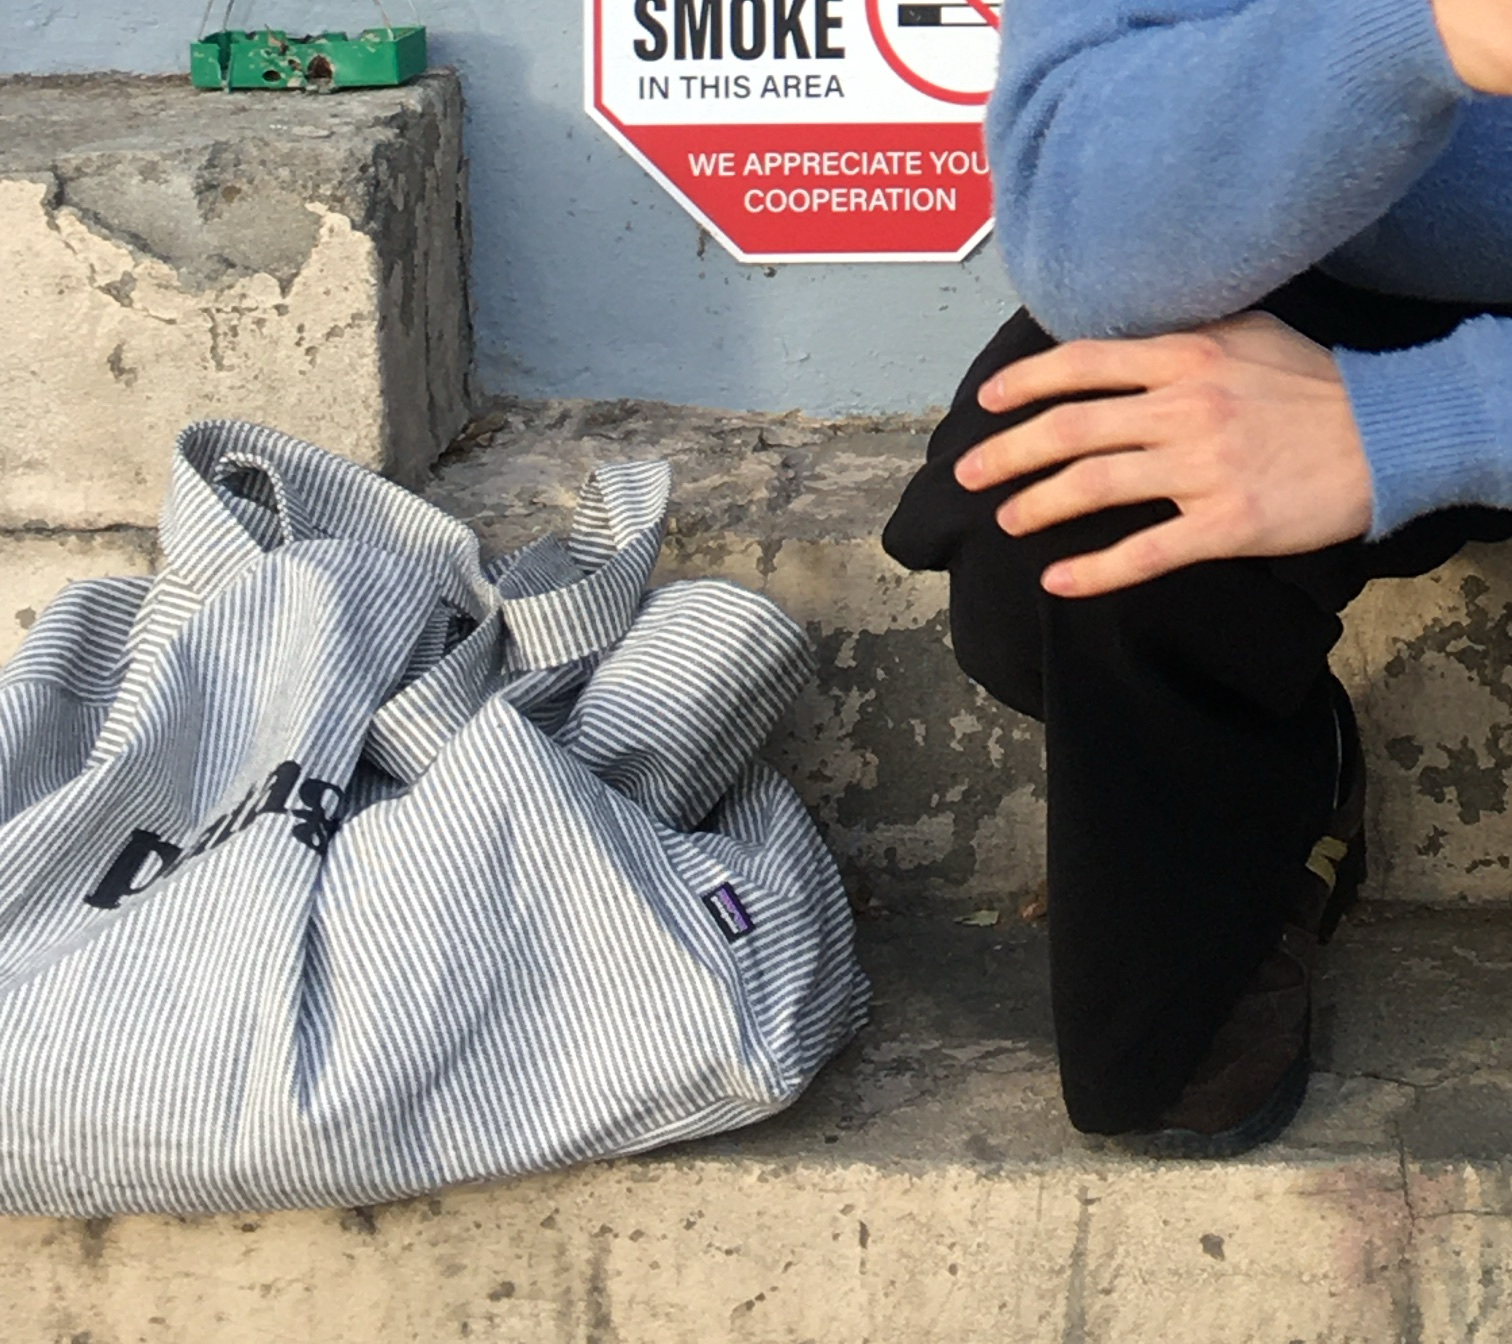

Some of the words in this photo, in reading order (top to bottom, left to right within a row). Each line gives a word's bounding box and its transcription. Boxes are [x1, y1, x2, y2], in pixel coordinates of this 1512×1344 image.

[638, 76, 671, 100] IN
[680, 75, 751, 100] THIS
[760, 75, 845, 99] AREA
[688, 152, 736, 177] WE
[742, 151, 922, 176] APPRECIATE
[928, 150, 990, 175] YOU
[744, 187, 957, 213] COOPERATION
